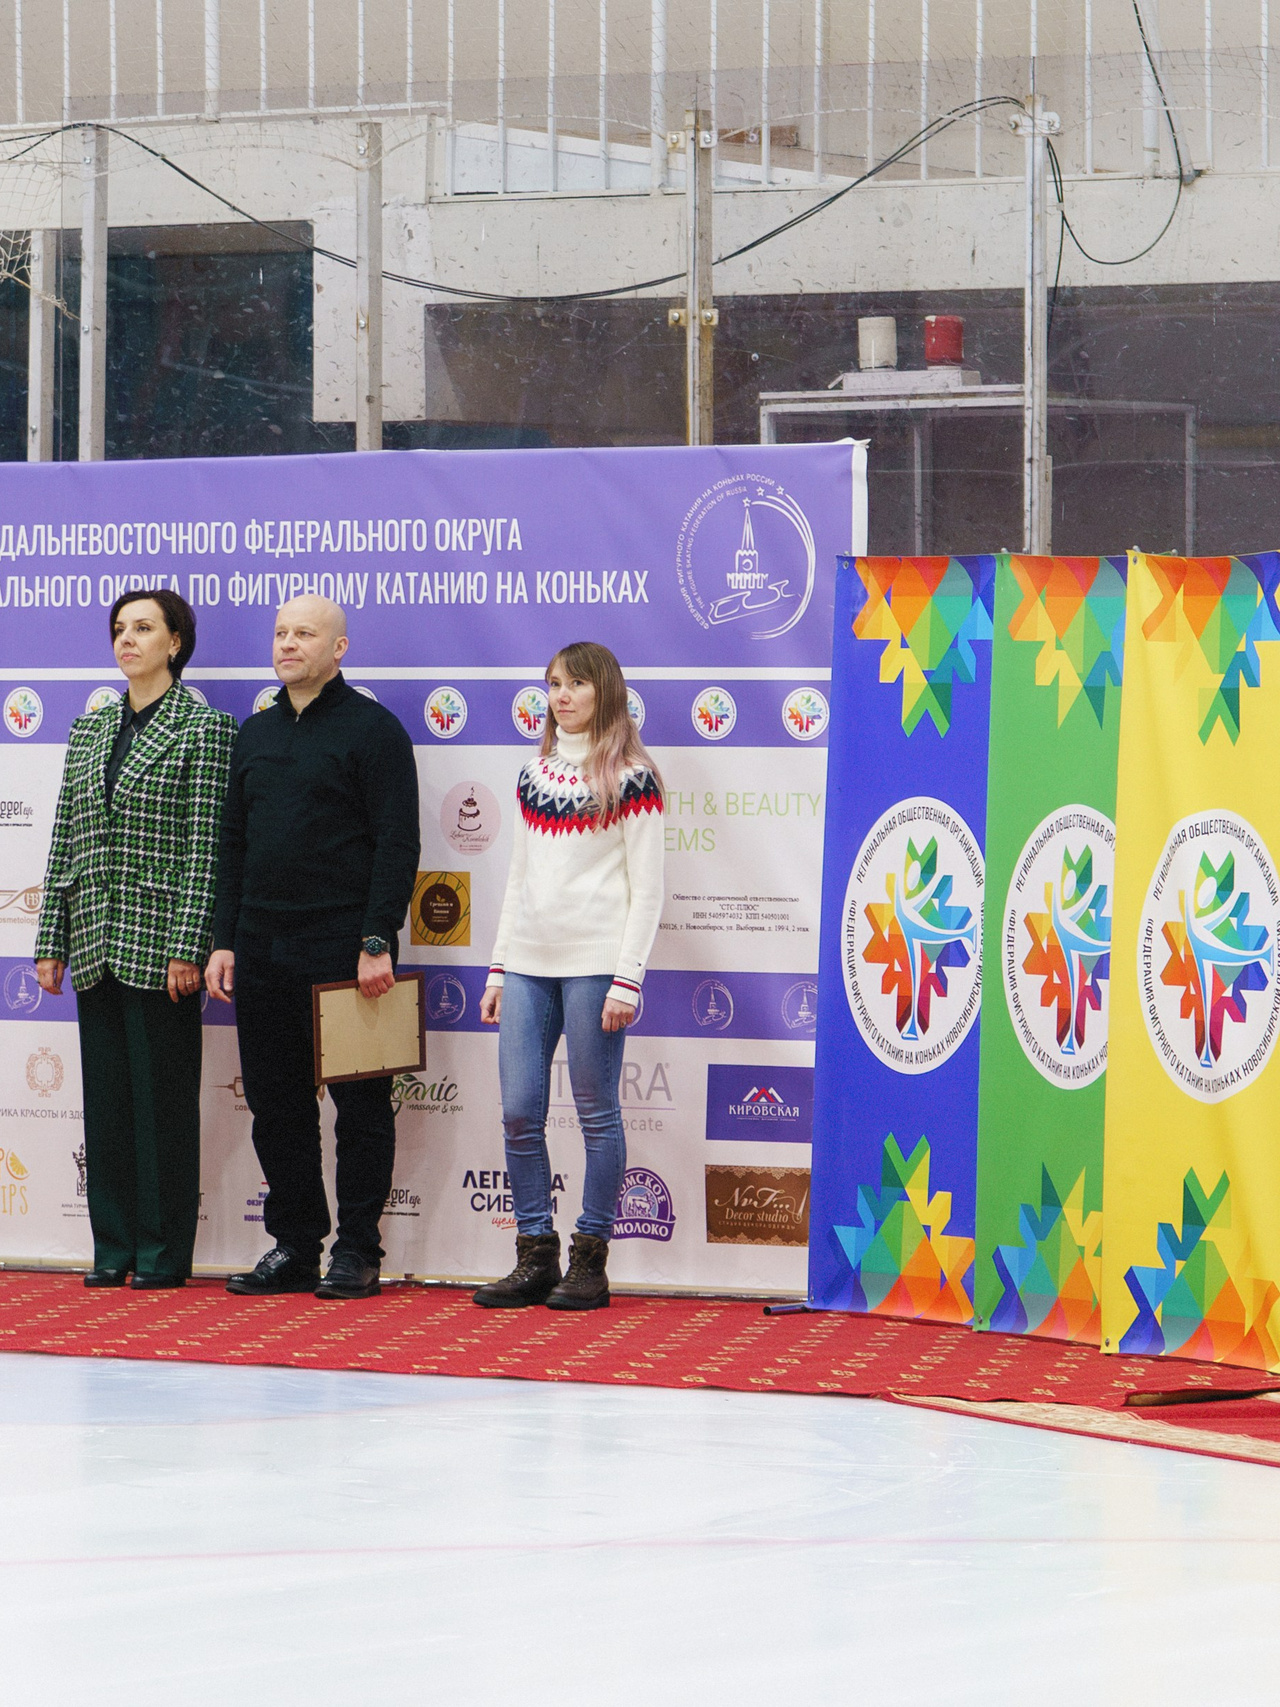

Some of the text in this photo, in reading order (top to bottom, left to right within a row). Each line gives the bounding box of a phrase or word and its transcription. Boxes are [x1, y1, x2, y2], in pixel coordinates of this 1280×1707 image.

[681, 498, 703, 532] КАТАНИЯ
[702, 489, 712, 499] НА
[713, 474, 744, 491] КОНЬКАХ
[746, 473, 776, 486] РОССИИ
[244, 518, 426, 558] ФЕДЕРАЛЬНОГО
[434, 518, 523, 556] ОКРУГА
[686, 537, 694, 569] SKATING
[692, 499, 717, 537] FEDERATION
[716, 492, 725, 502] OF
[726, 486, 747, 497] RUSSIA
[189, 573, 221, 606] ПО
[227, 571, 369, 610] ФИГУРНОМУ
[376, 571, 488, 605] КАТАНИЮ
[496, 571, 527, 604] НА
[535, 570, 650, 604] КОНЬКАХ
[702, 792, 718, 816] &
[725, 793, 821, 817] BEAUTY
[856, 805, 985, 888] РЕГИОНАЛЬНАЯ ОБЩЕСТВЕННАЯ ОРГАНИЗАЦИЯ
[1015, 823, 1055, 893] РЕГИОНАЛЬНАЯ
[1055, 813, 1105, 835] ОБЩЕСТВЕННАЯ
[1153, 819, 1280, 907] РЕГИОНАЛЬНАЯ ОБЩЕСТВЕННАЯ ОРГАНИЗАЦИЯ
[851, 978, 878, 1042] ФИГУРНОГО
[876, 1035, 904, 1064] КАТАНИЯ
[904, 1051, 914, 1065] НА
[915, 1040, 946, 1065] КОНЬКАХ
[1012, 990, 1038, 1056] ФИГУРНОГО
[1036, 1050, 1064, 1079] КАТАНИЯ
[1063, 1066, 1072, 1080] НА
[1072, 1057, 1101, 1080] КОНЬКАХ
[1148, 1001, 1177, 1067] ФИГУРНОГО
[1175, 1062, 1205, 1093] КАТАНИЯ
[1204, 1077, 1212, 1093] НА
[1211, 1069, 1242, 1093] КОНЬКАХ
[391, 1075, 459, 1102] ganic
[20, 1109, 59, 1119] КРАСОТЫ
[60, 1110, 67, 1119] И
[449, 1104, 464, 1115] spa
[729, 1104, 800, 1117] КИРОВСКАЯ
[462, 1170, 565, 1192] ЛЕГЕА
[619, 1172, 667, 1205] ОМСКОЕ
[613, 1222, 669, 1238] МОЛОКО
[725, 1207, 790, 1224] Decor studio
